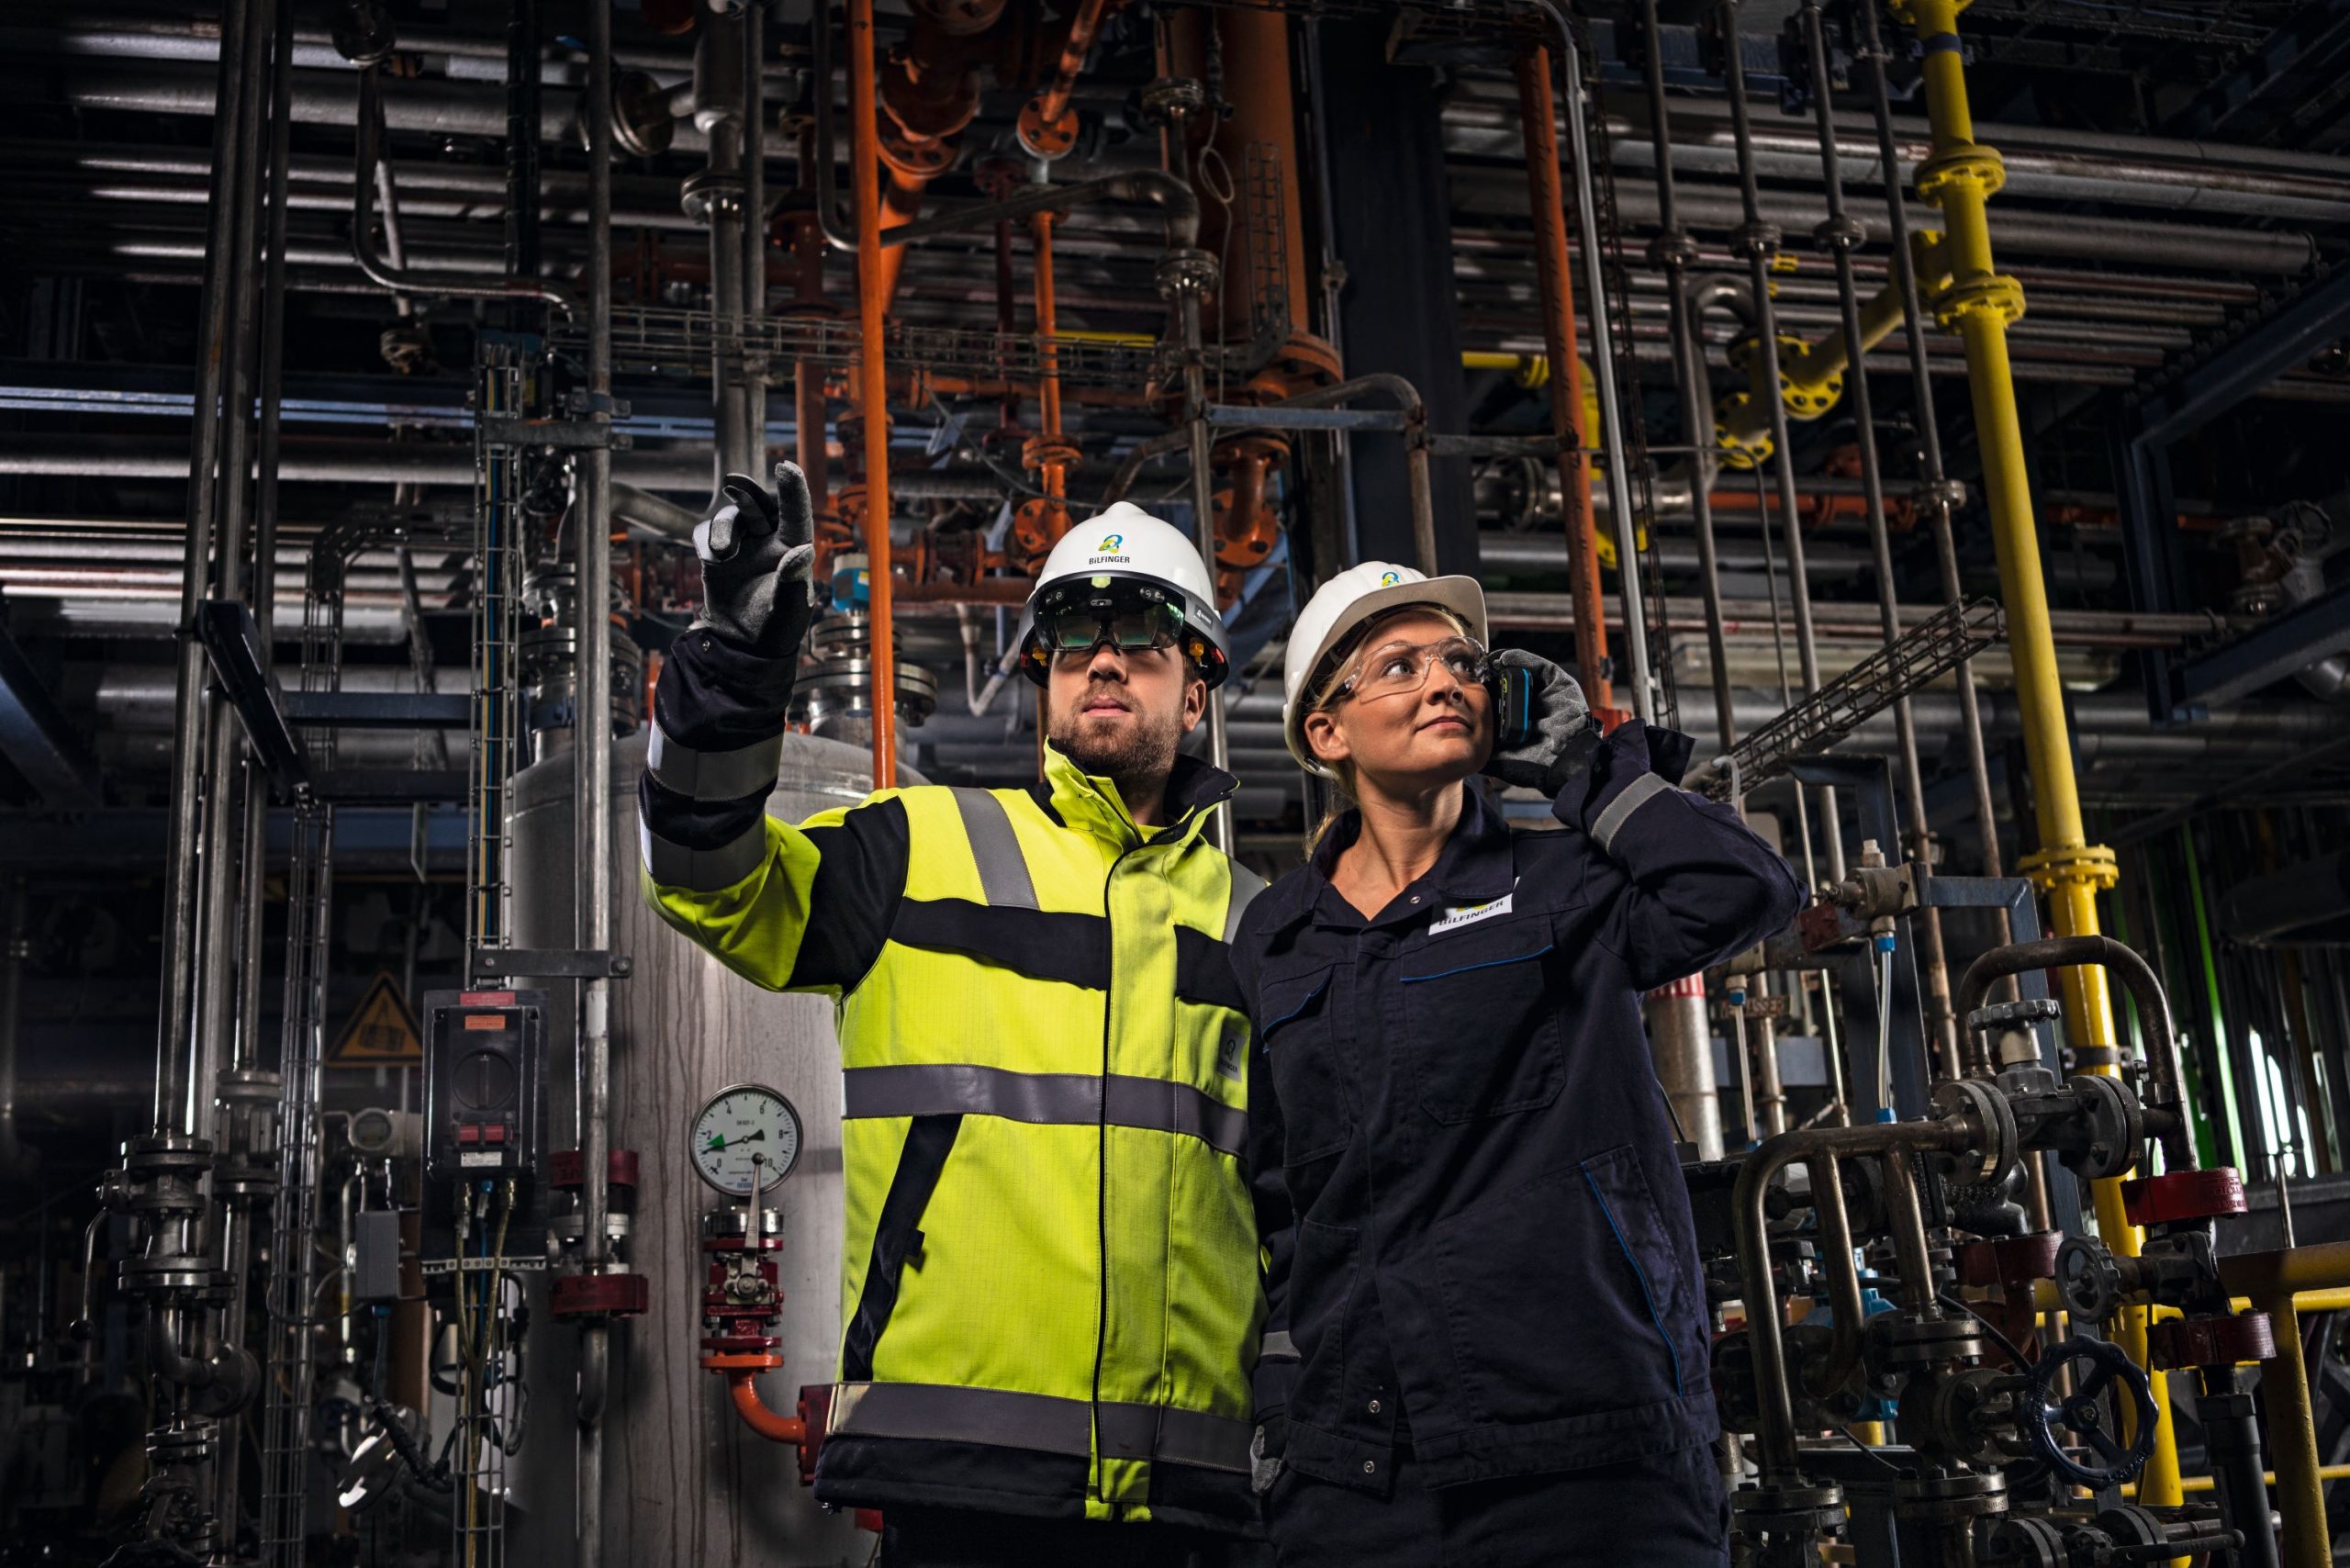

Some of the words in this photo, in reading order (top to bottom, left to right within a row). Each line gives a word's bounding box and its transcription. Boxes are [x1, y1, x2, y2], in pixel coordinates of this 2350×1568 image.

[726, 1105, 732, 1114] 4
[759, 1105, 764, 1114] 6
[707, 1130, 711, 1139] 2
[778, 1129, 783, 1138] 8
[717, 1158, 722, 1168] 0
[764, 1158, 773, 1168] 10
